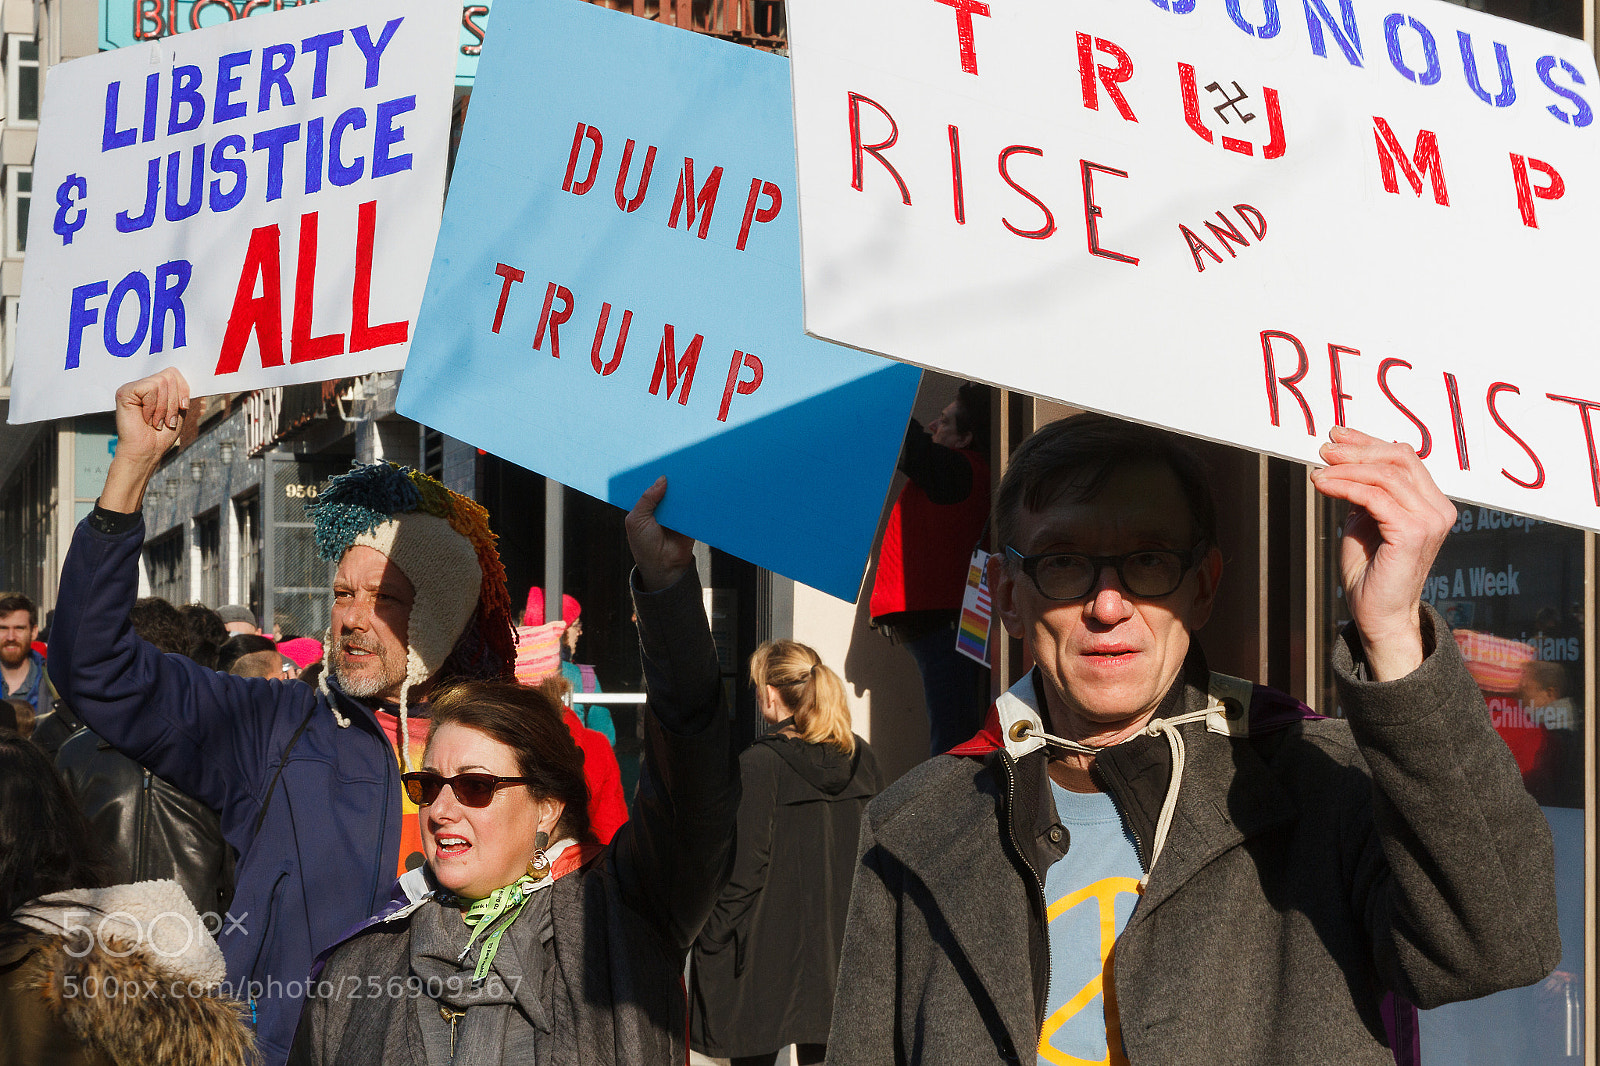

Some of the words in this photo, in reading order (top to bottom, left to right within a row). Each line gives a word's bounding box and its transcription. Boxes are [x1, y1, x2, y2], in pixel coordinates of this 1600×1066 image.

[101, 17, 405, 152] LIBERTY
[934, 0, 1566, 229] TRUMP
[53, 172, 88, 246] &
[115, 95, 416, 233] JUSTICE
[562, 122, 783, 251] DUMP
[848, 91, 1140, 267] RISE
[1178, 203, 1268, 273] AND
[64, 259, 193, 371] FOR
[214, 200, 410, 376] ALL
[491, 262, 764, 422] TRUMP
[1260, 329, 1600, 507] RESIST
[285, 483, 318, 498] 956
[1452, 568, 1466, 598] A
[1469, 564, 1520, 597] Week
[1477, 631, 1580, 667] Physicians
[1488, 698, 1568, 731] Children
